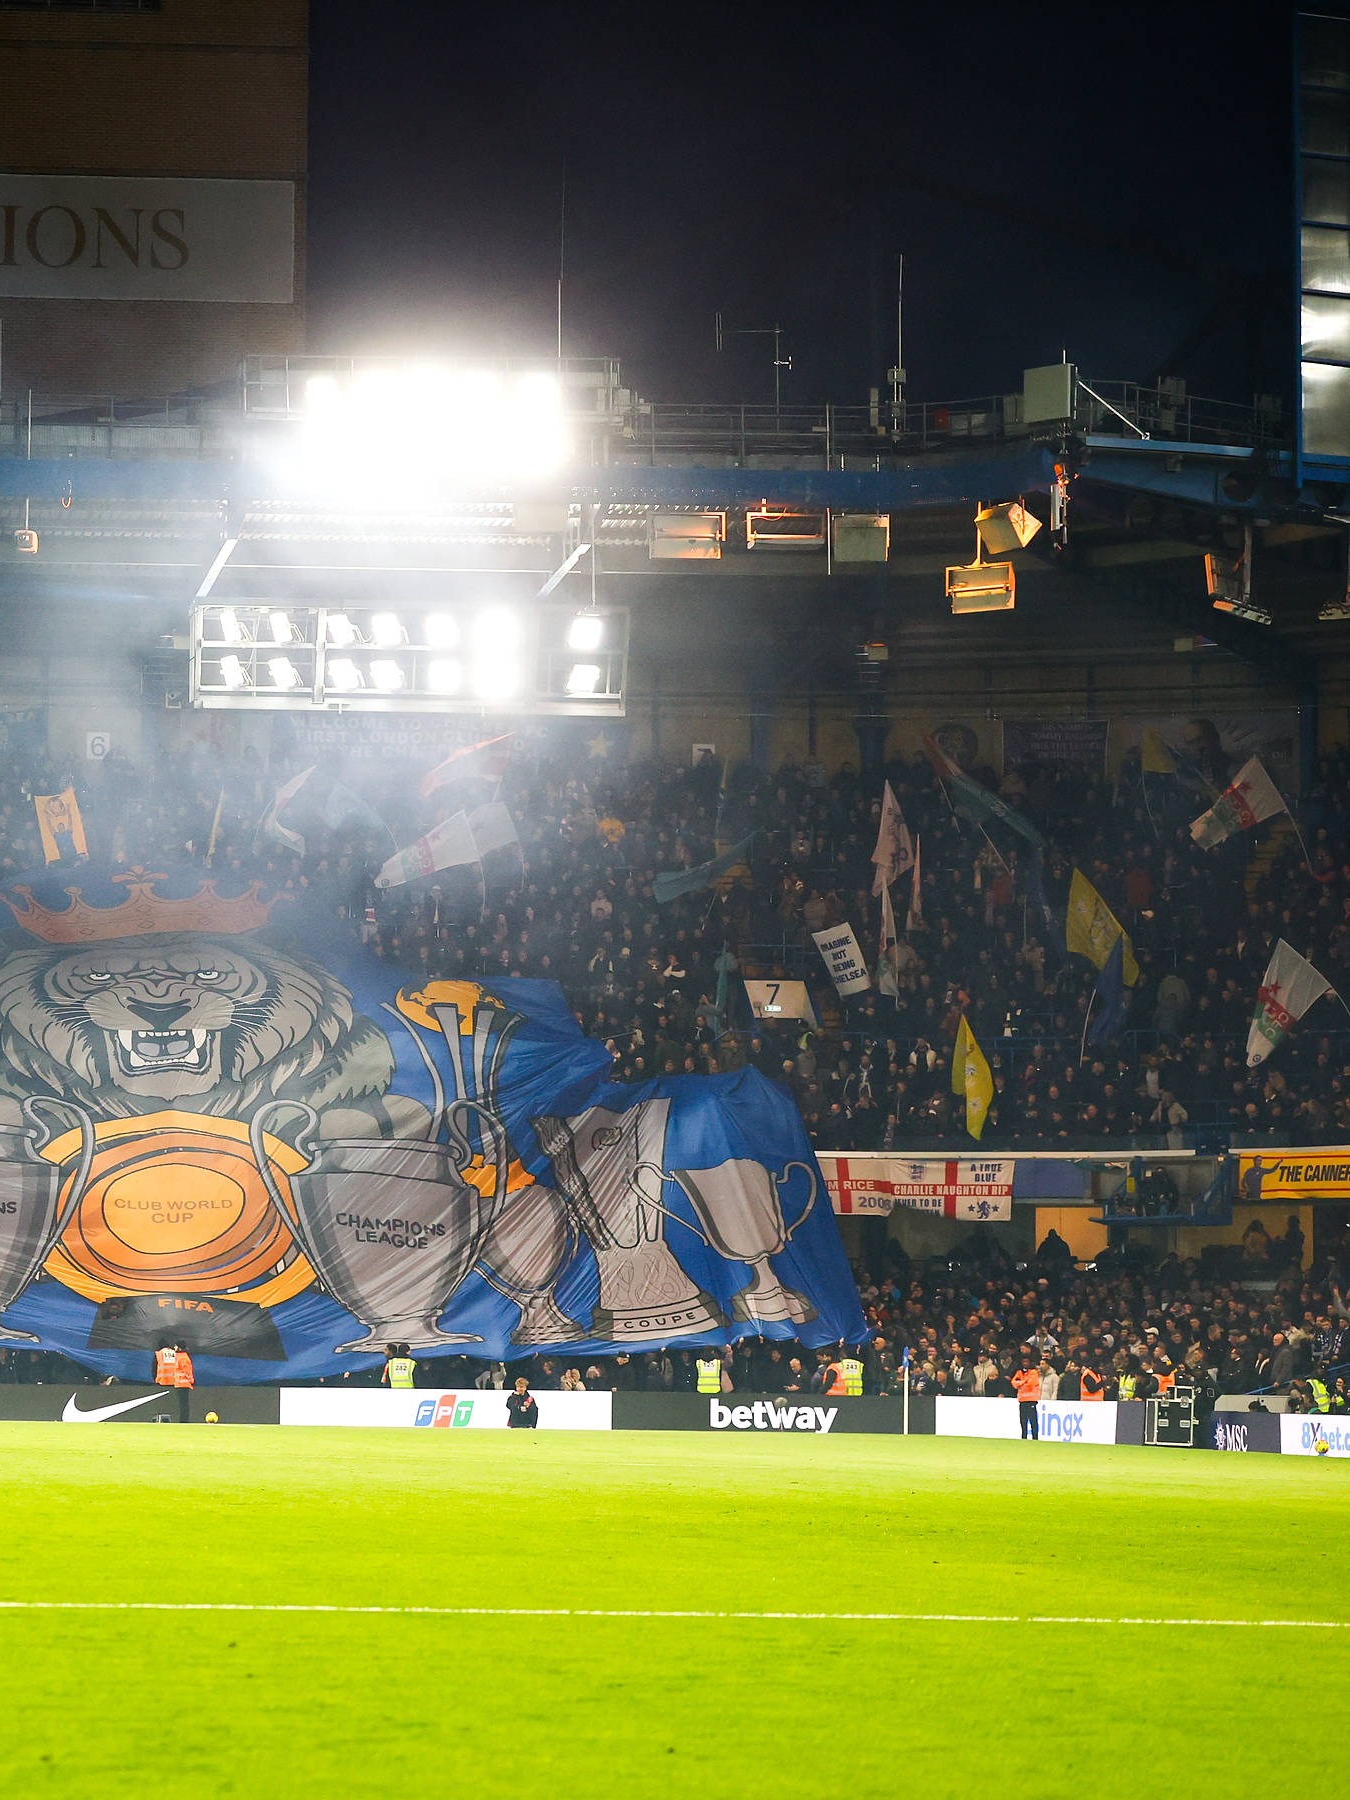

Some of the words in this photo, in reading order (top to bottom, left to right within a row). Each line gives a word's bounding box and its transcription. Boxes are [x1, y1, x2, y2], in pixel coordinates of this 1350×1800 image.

[90, 736, 105, 756] 6
[766, 984, 780, 1005] 7
[970, 1164, 977, 1172] A
[980, 1163, 1003, 1172] TRUE
[1279, 1165, 1303, 1182] THE
[843, 1180, 875, 1190] RICE
[974, 1173, 997, 1182] BLUE
[894, 1185, 934, 1195] CHARLIE
[936, 1185, 989, 1195] NAUGHTON
[991, 1186, 1009, 1195] RIP
[114, 1199, 162, 1210] CLUB
[166, 1199, 233, 1210] WORLD
[152, 1213, 194, 1223] CUP
[336, 1212, 446, 1237] CHAMPIONS
[355, 1229, 429, 1249] LEAGUE
[157, 1298, 215, 1313] FIFA
[624, 1312, 696, 1329] COUPE
[709, 1398, 838, 1434] betway
[1225, 1423, 1249, 1452] MSC
